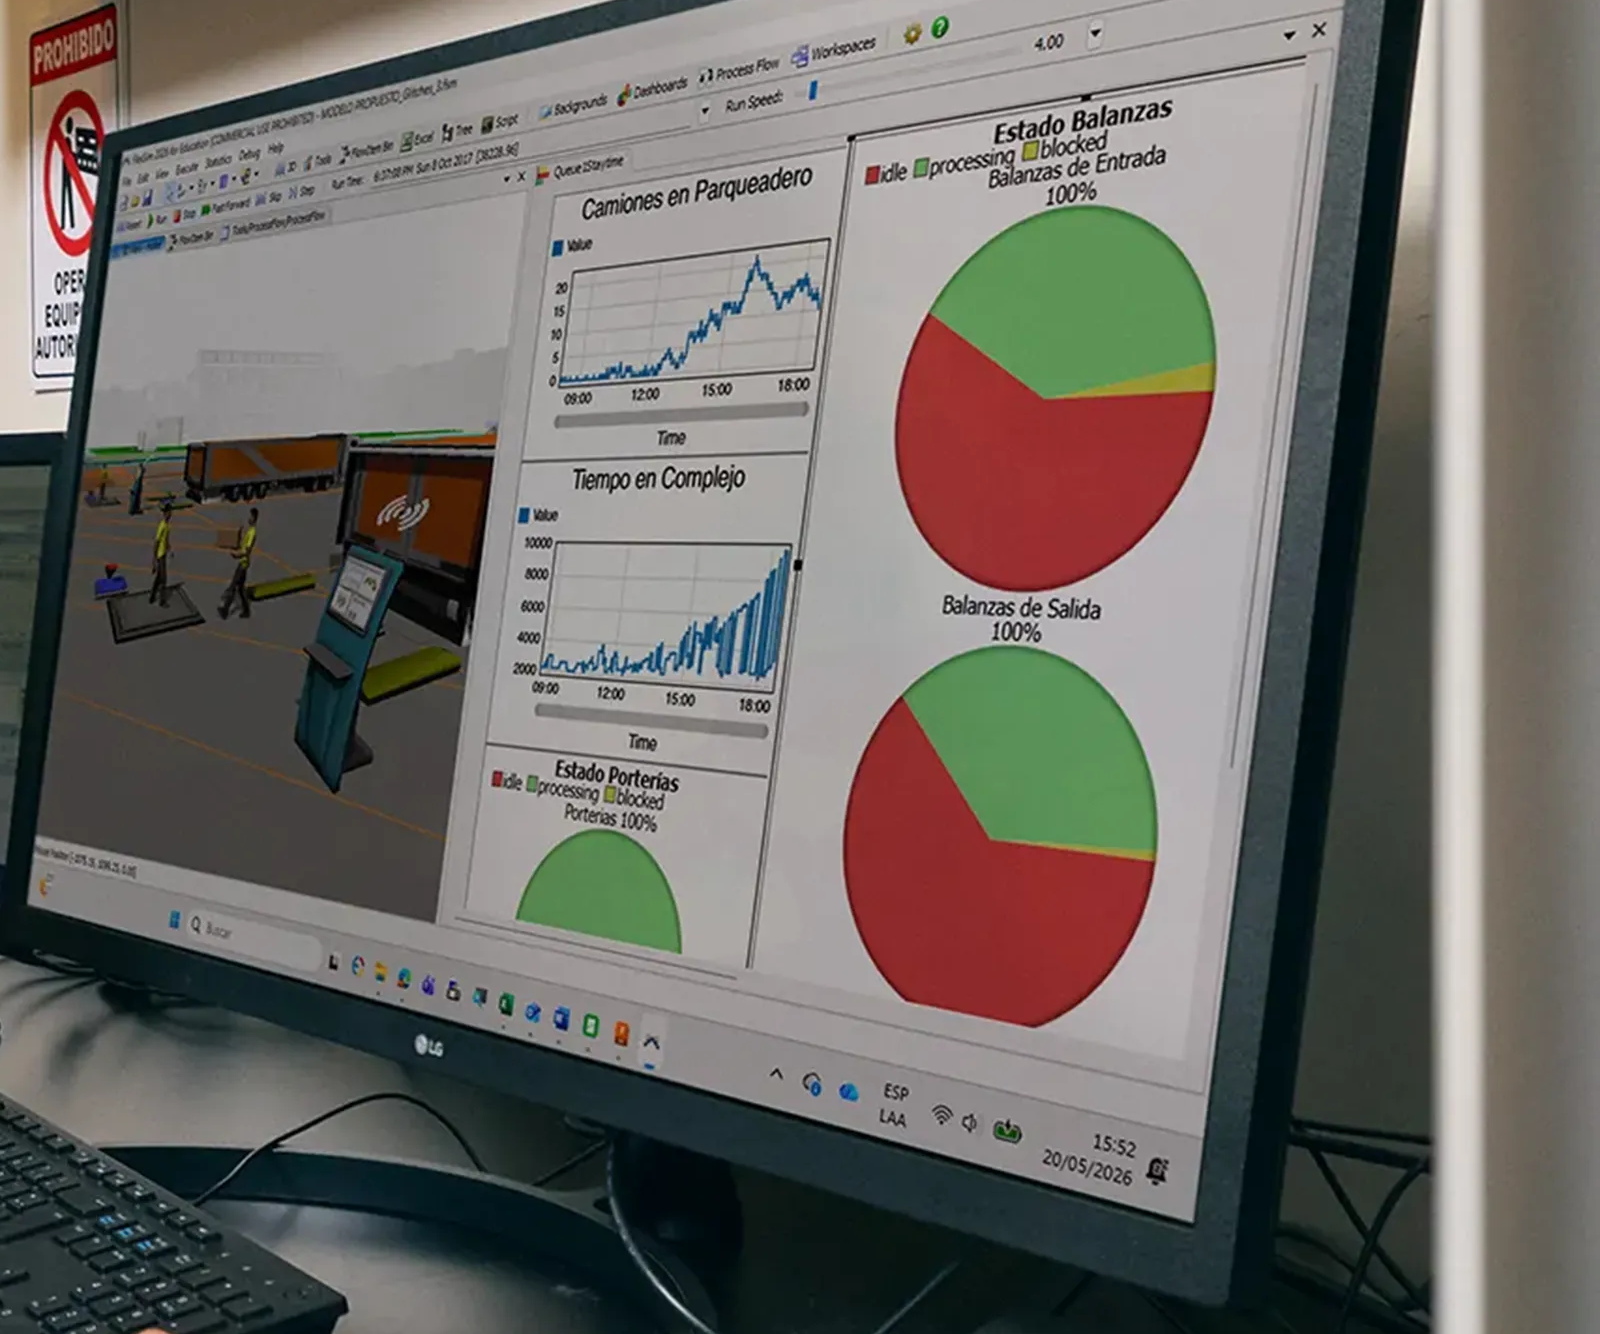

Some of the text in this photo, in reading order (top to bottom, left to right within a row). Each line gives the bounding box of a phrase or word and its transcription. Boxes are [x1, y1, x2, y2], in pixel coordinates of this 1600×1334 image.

[34, 27, 114, 76] PROHIBIDO
[1034, 32, 1064, 51] 4.00
[315, 154, 333, 168] Tools
[414, 131, 434, 147] Excel
[456, 124, 473, 137] Tree
[495, 112, 519, 131] Script
[554, 92, 608, 122] Backgrounds
[633, 76, 688, 101] Dashboards
[716, 61, 755, 83] Process
[756, 58, 780, 73] Flow
[811, 35, 877, 62] Workspaces
[726, 89, 784, 115] Run Speed:
[994, 98, 1174, 145] Estado Balanzas
[180, 139, 210, 155] Education
[880, 131, 1108, 183] idle processing blocked
[176, 161, 199, 176] Execute
[239, 148, 261, 163] Debug
[268, 141, 285, 155] Help
[416, 160, 431, 176] Sun
[439, 154, 453, 169] Oct
[988, 145, 1167, 189] Balanzas de Entrada
[582, 167, 813, 220] Camiones en Parqueadero
[1046, 181, 1097, 207] 100%
[567, 239, 592, 252] Value
[55, 269, 85, 296] OPER
[556, 283, 569, 294] 20
[45, 301, 80, 328] EQUIP
[554, 306, 566, 317] 15
[551, 329, 563, 340] 10
[552, 353, 559, 364] 5
[549, 376, 557, 387] 0
[564, 378, 811, 405] 09:00 12:00 15:00 18:00
[657, 430, 686, 446] Time
[573, 464, 746, 494] Tiempo en Complejo
[533, 508, 559, 522] Value
[525, 537, 553, 549] 10000
[525, 568, 549, 580] 8000
[521, 601, 545, 613] 6000
[942, 594, 1102, 621] Balanzas de Salida
[517, 632, 542, 644] 4000
[992, 621, 1042, 643] 100%
[513, 663, 537, 675] 2000
[532, 681, 771, 714] 09:00 12:00 15:00 18:00
[629, 733, 657, 751] Time
[555, 759, 680, 793] Estado Porterías
[503, 772, 664, 811] idle processing blocked
[621, 812, 658, 833] 100%
[428, 1041, 444, 1057] LG
[884, 1082, 910, 1102] ESP
[879, 1108, 908, 1129] LAA
[1093, 1132, 1137, 1159] 15:52
[1042, 1147, 1134, 1187] 20/05/2026
